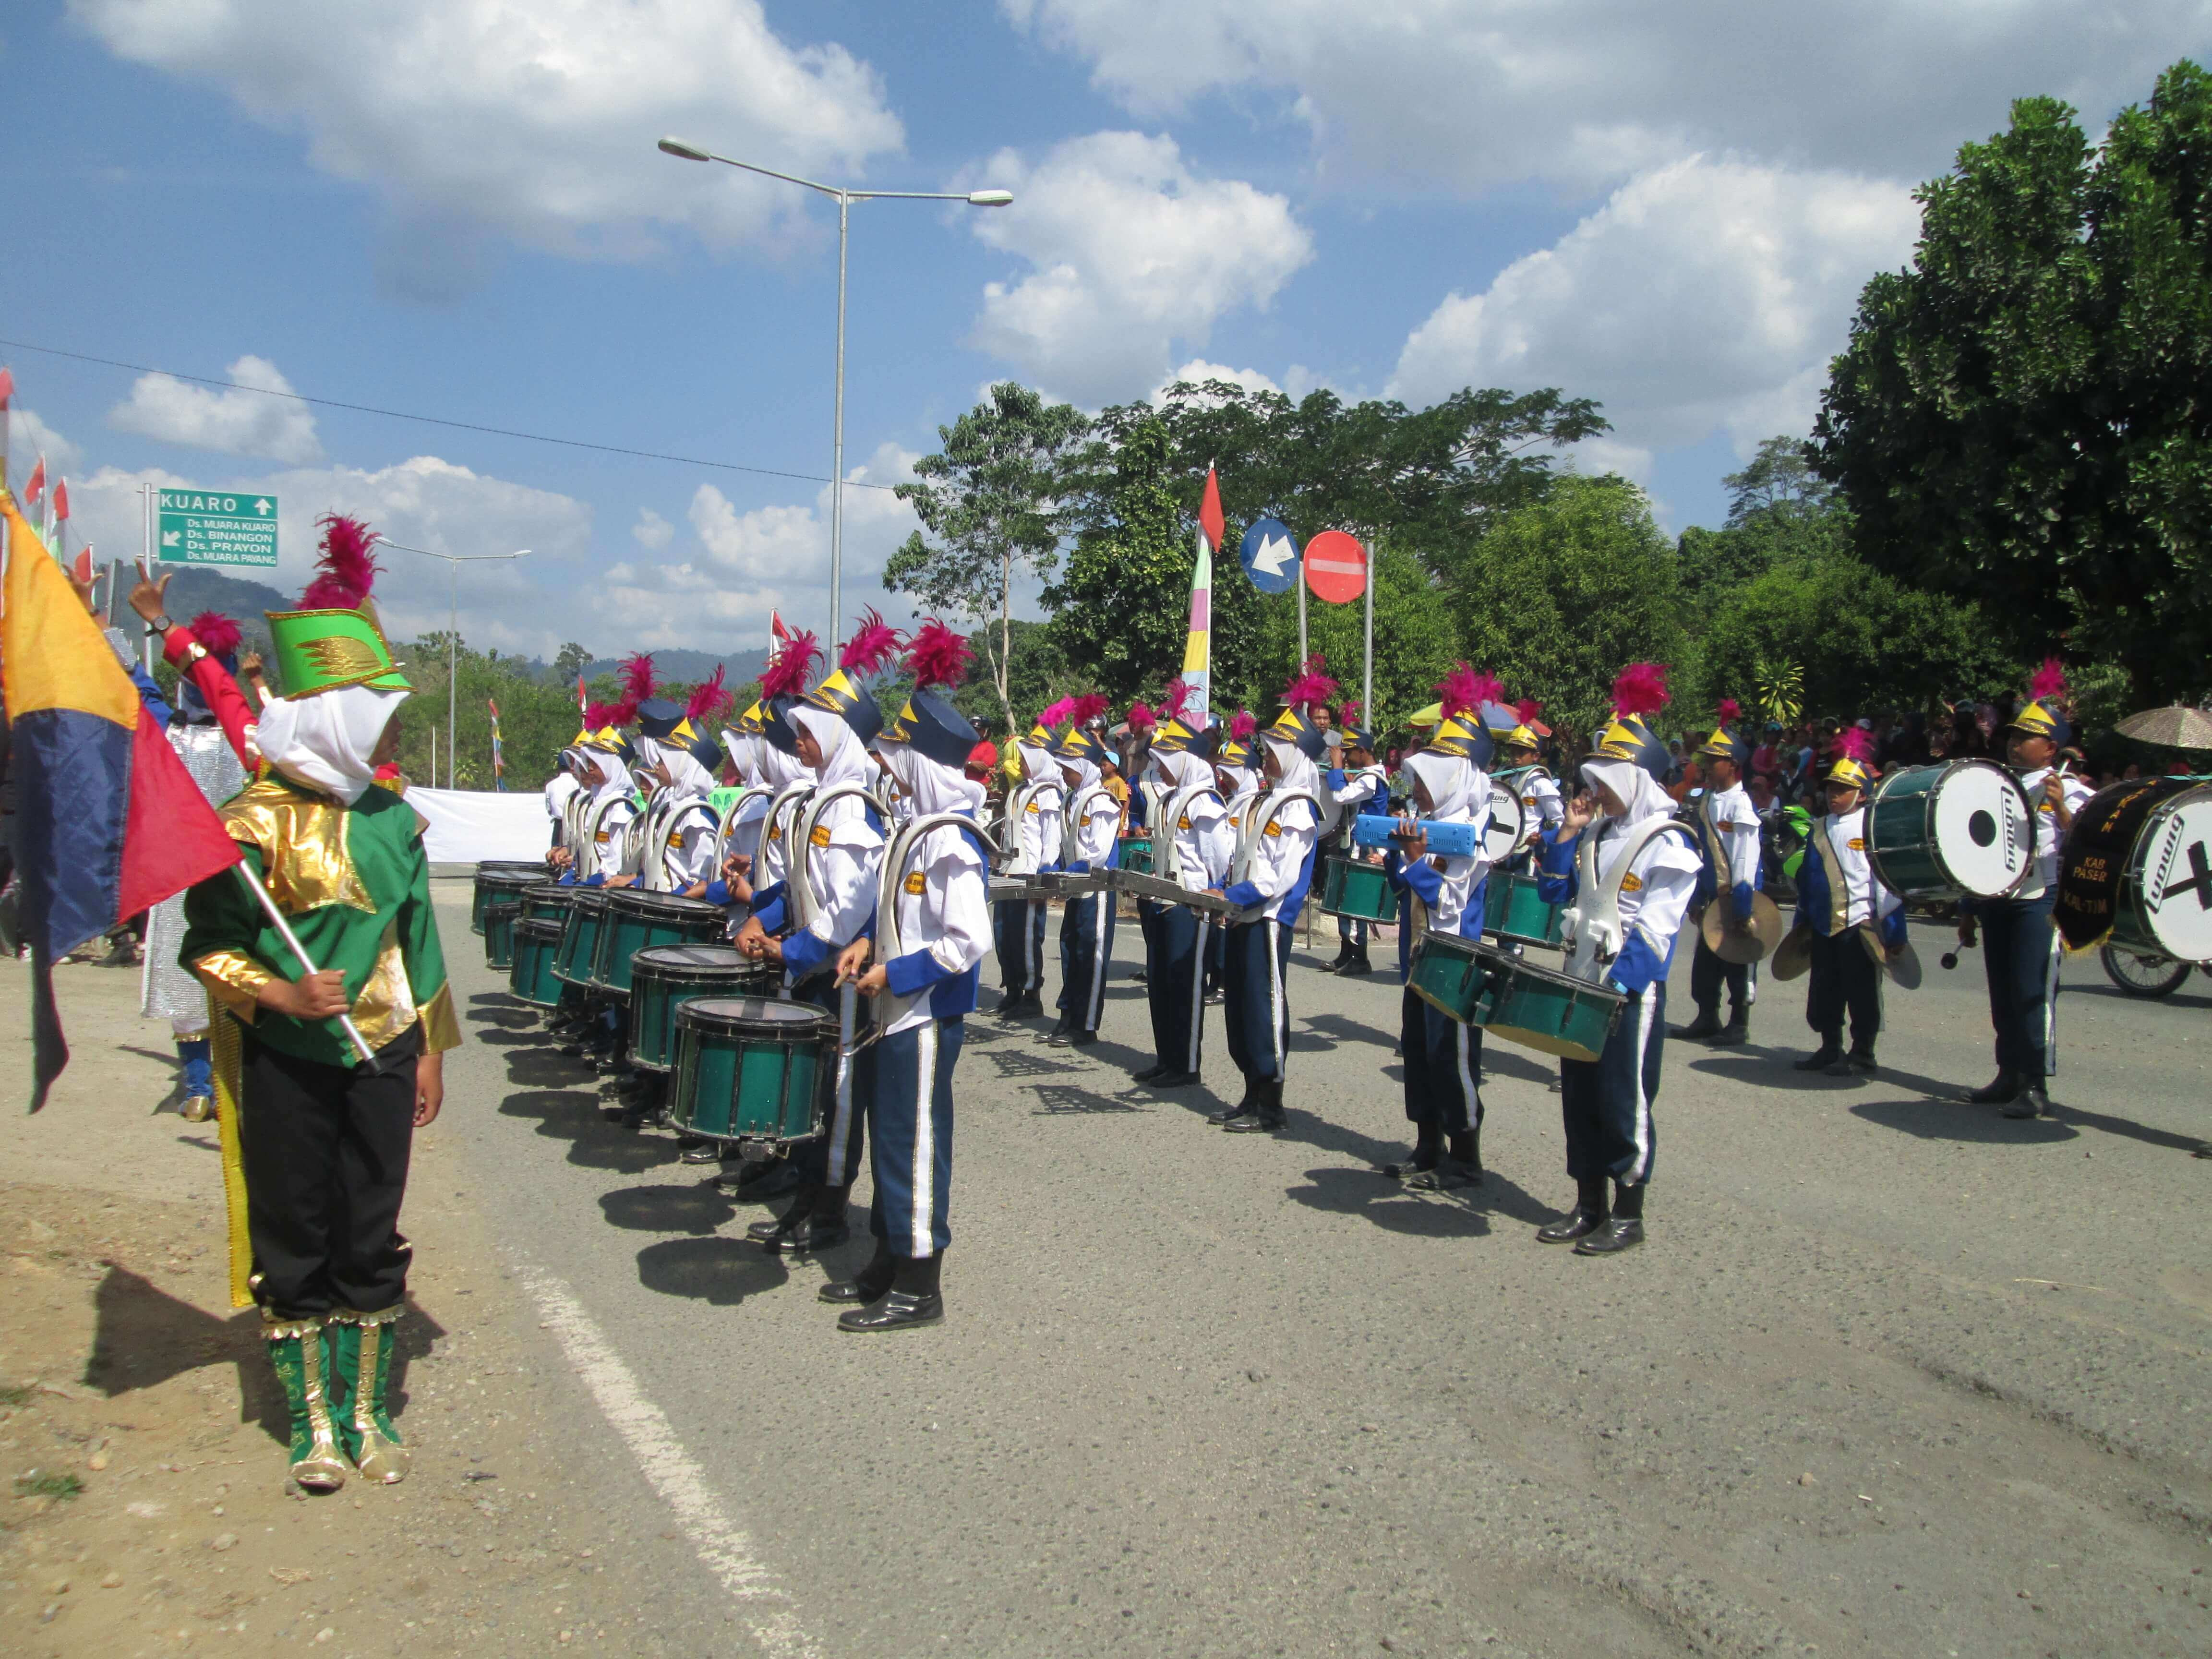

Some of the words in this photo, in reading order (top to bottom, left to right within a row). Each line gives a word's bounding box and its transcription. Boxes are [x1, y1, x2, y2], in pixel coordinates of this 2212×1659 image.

[161, 494, 237, 512] KUARO
[204, 520, 240, 530] MUARA
[241, 523, 275, 532] KUARO
[187, 530, 205, 539] Ds.
[209, 531, 272, 542] BINANGON
[187, 541, 208, 550] Ds.
[212, 542, 271, 553] PRAYON
[204, 553, 239, 562] MUARA
[241, 554, 276, 564] PAYANG
[2085, 857, 2105, 868] KAB
[2073, 866, 2107, 881] PASER
